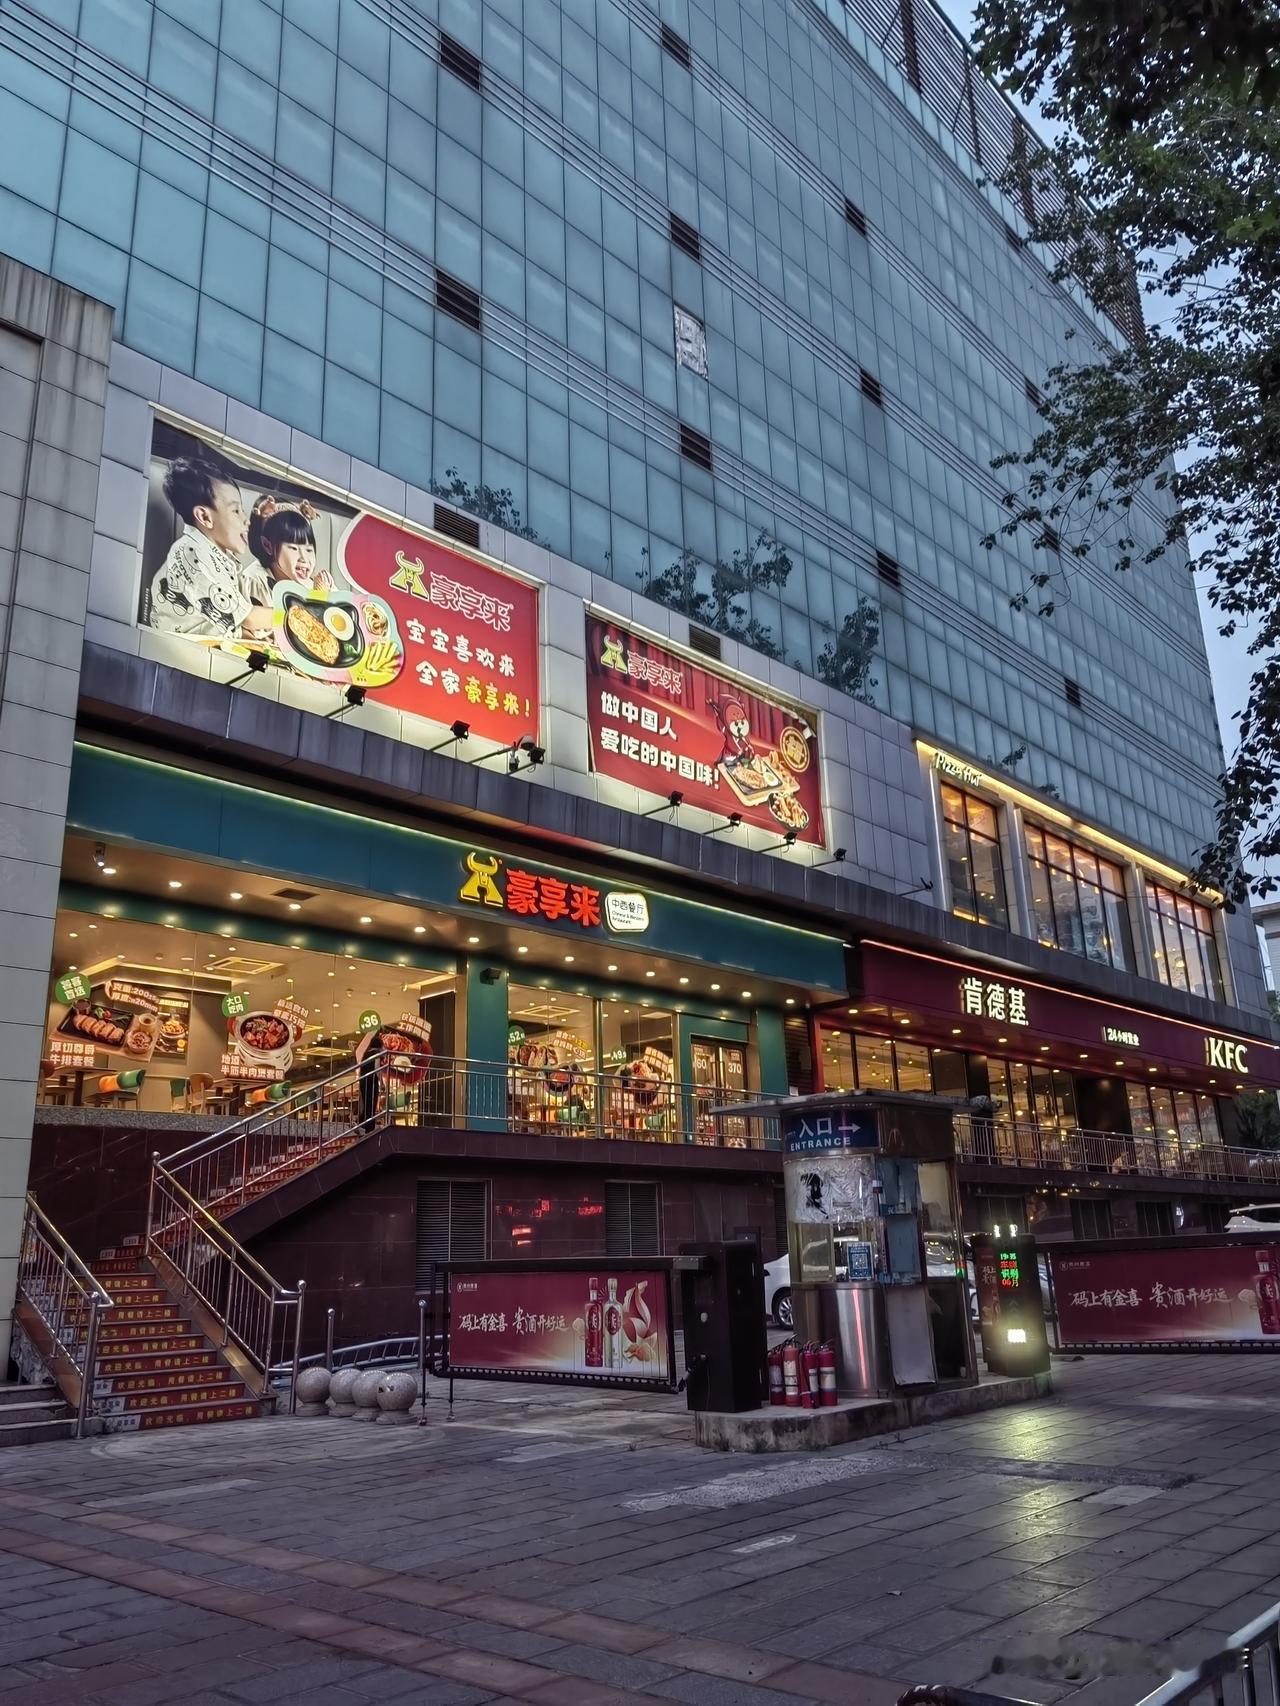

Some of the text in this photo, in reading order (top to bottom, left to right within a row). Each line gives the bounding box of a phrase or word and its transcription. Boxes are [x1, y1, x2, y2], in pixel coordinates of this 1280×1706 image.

[430, 571, 511, 631] 豪享来
[405, 618, 515, 677] 宝宝喜欢来
[416, 660, 530, 717] 全家豪享来！
[627, 650, 682, 694] 豪享来
[601, 691, 678, 741] 做中国人
[601, 727, 720, 789] 爱吃的中国味！
[506, 868, 600, 927] 豪享来
[611, 898, 644, 914] 中西餐厅
[226, 995, 242, 1005] 大口
[228, 1004, 244, 1014] 吃肉
[964, 977, 1029, 1026] 肯德基
[49, 1054, 94, 1067] 牛排套餐
[1209, 1037, 1249, 1074] KFC
[790, 1136, 852, 1152] ENTRANCE
[799, 1117, 833, 1138] 入口
[1150, 1281, 1233, 1309] 贵酒开好运
[512, 1306, 570, 1336] 贵酒开好运
